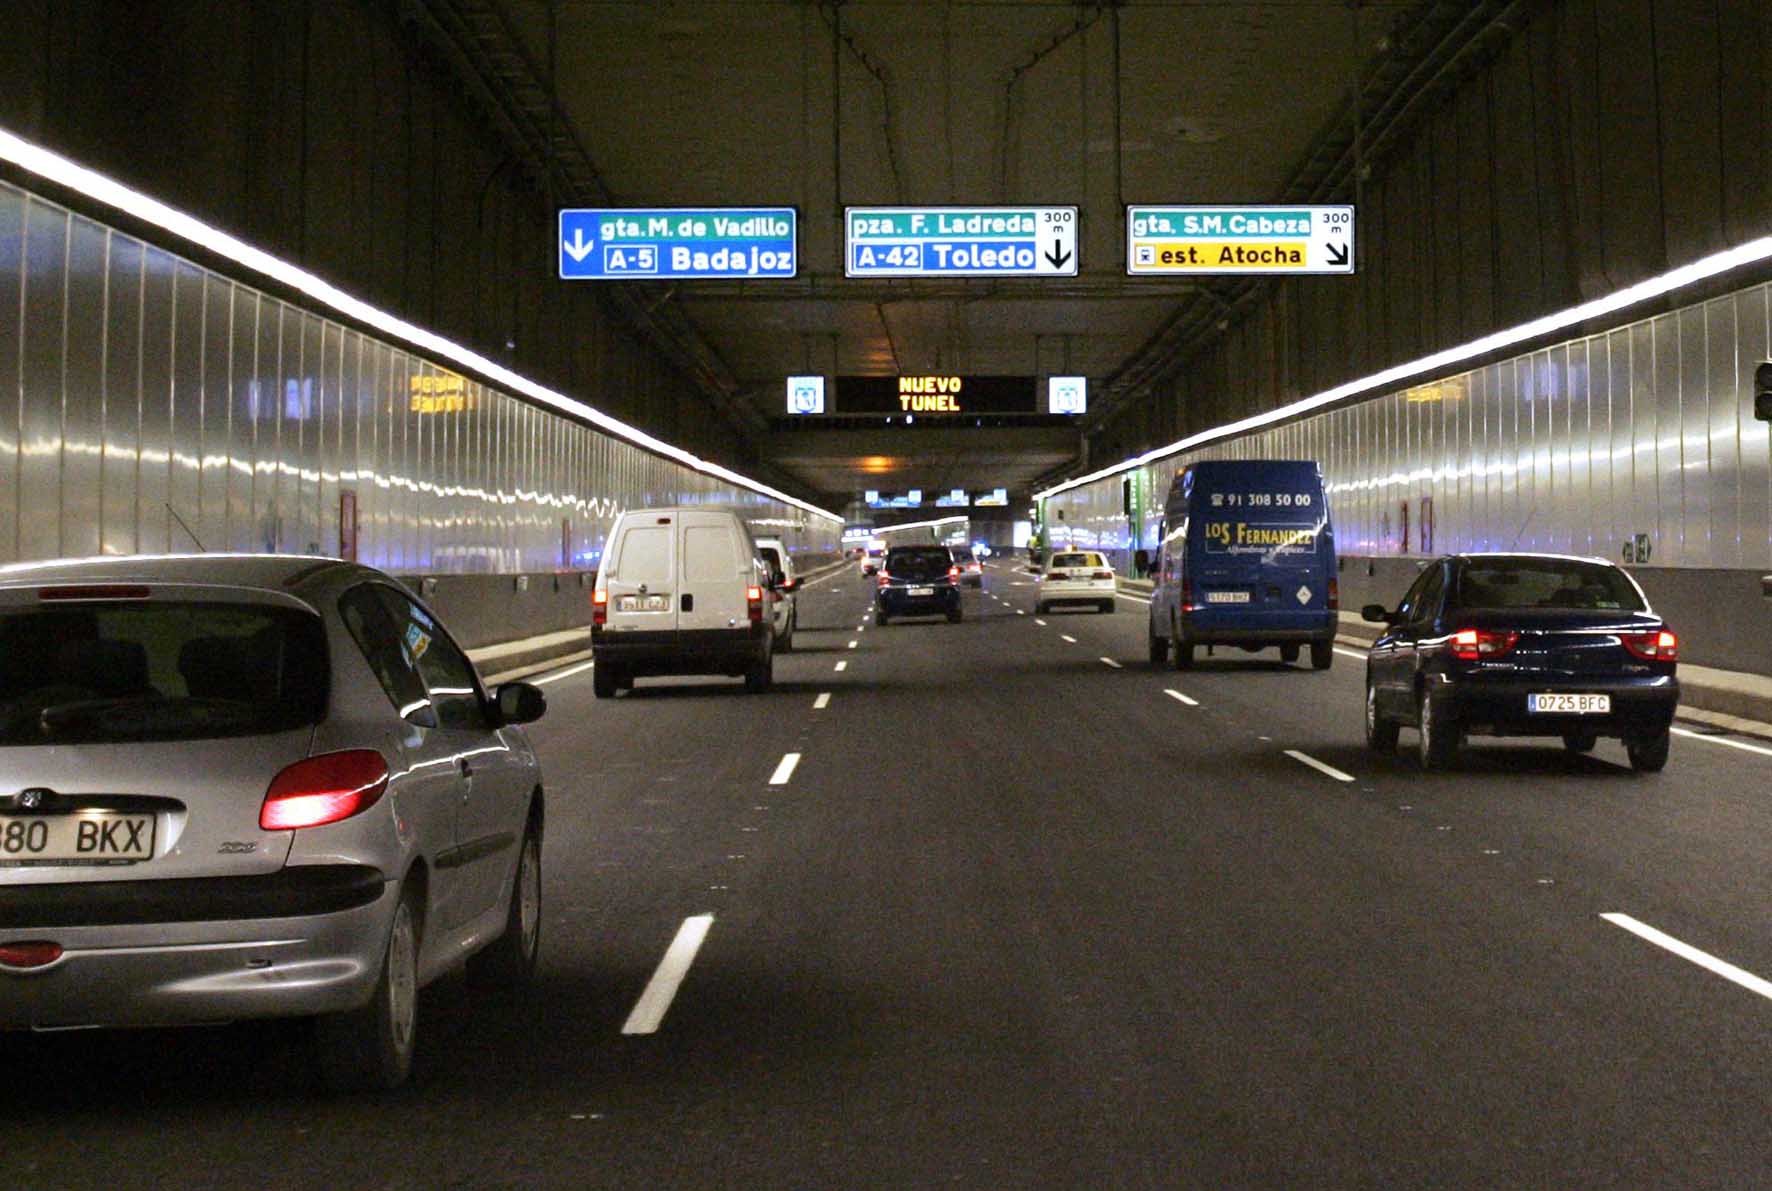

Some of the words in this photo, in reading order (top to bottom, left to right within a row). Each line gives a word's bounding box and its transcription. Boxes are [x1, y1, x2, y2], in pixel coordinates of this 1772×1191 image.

[853, 217, 902, 238] pza.
[911, 214, 929, 234] F.
[938, 214, 1035, 234] Ladreda
[1044, 212, 1071, 222] 300
[1229, 215, 1311, 234] Cabeza
[1323, 213, 1349, 223] 300
[601, 218, 645, 240] gta.
[649, 218, 673, 236] M.
[678, 217, 706, 236] de
[713, 217, 788, 236] Vadillo
[1053, 225, 1063, 233] m
[609, 249, 653, 269] A-5
[671, 246, 792, 275] Badajoz
[858, 246, 919, 267] A-42
[933, 244, 1034, 269] Toledo
[1161, 246, 1205, 264] est.
[1219, 246, 1301, 264] Atocha
[899, 376, 961, 393] NUEVO
[899, 395, 960, 411] TUNEL
[1228, 494, 1242, 506] 91
[1248, 494, 1271, 506] 308
[1276, 494, 1291, 506] 50
[1295, 494, 1311, 506] 00
[1538, 695, 1575, 710] 0725
[1579, 695, 1606, 710] BFC
[0, 820, 49, 853] 80
[76, 819, 145, 853] BKX
